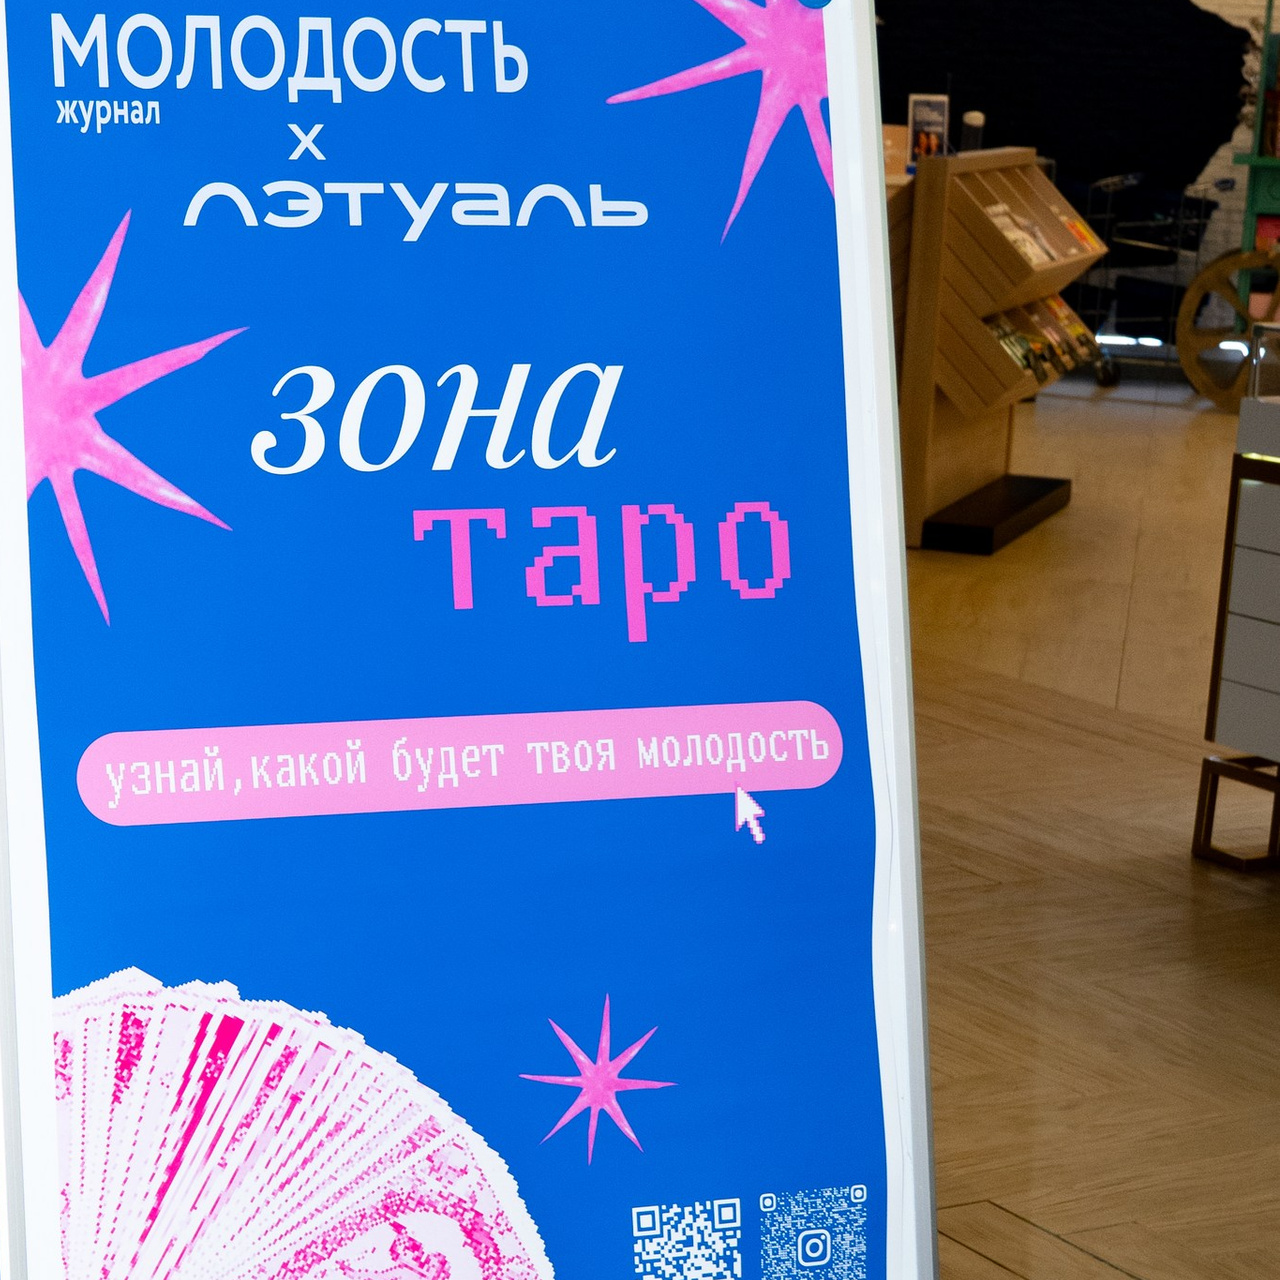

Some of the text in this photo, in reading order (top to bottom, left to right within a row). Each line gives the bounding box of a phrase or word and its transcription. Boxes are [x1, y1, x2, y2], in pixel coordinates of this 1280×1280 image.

[51, 13, 529, 104] МОЛОДОСТЬ
[55, 99, 161, 134] журнал
[250, 362, 624, 475] зона
[412, 501, 791, 643] таро
[391, 736, 505, 793] будет
[526, 738, 616, 774] твоя
[637, 726, 831, 773] молодость
